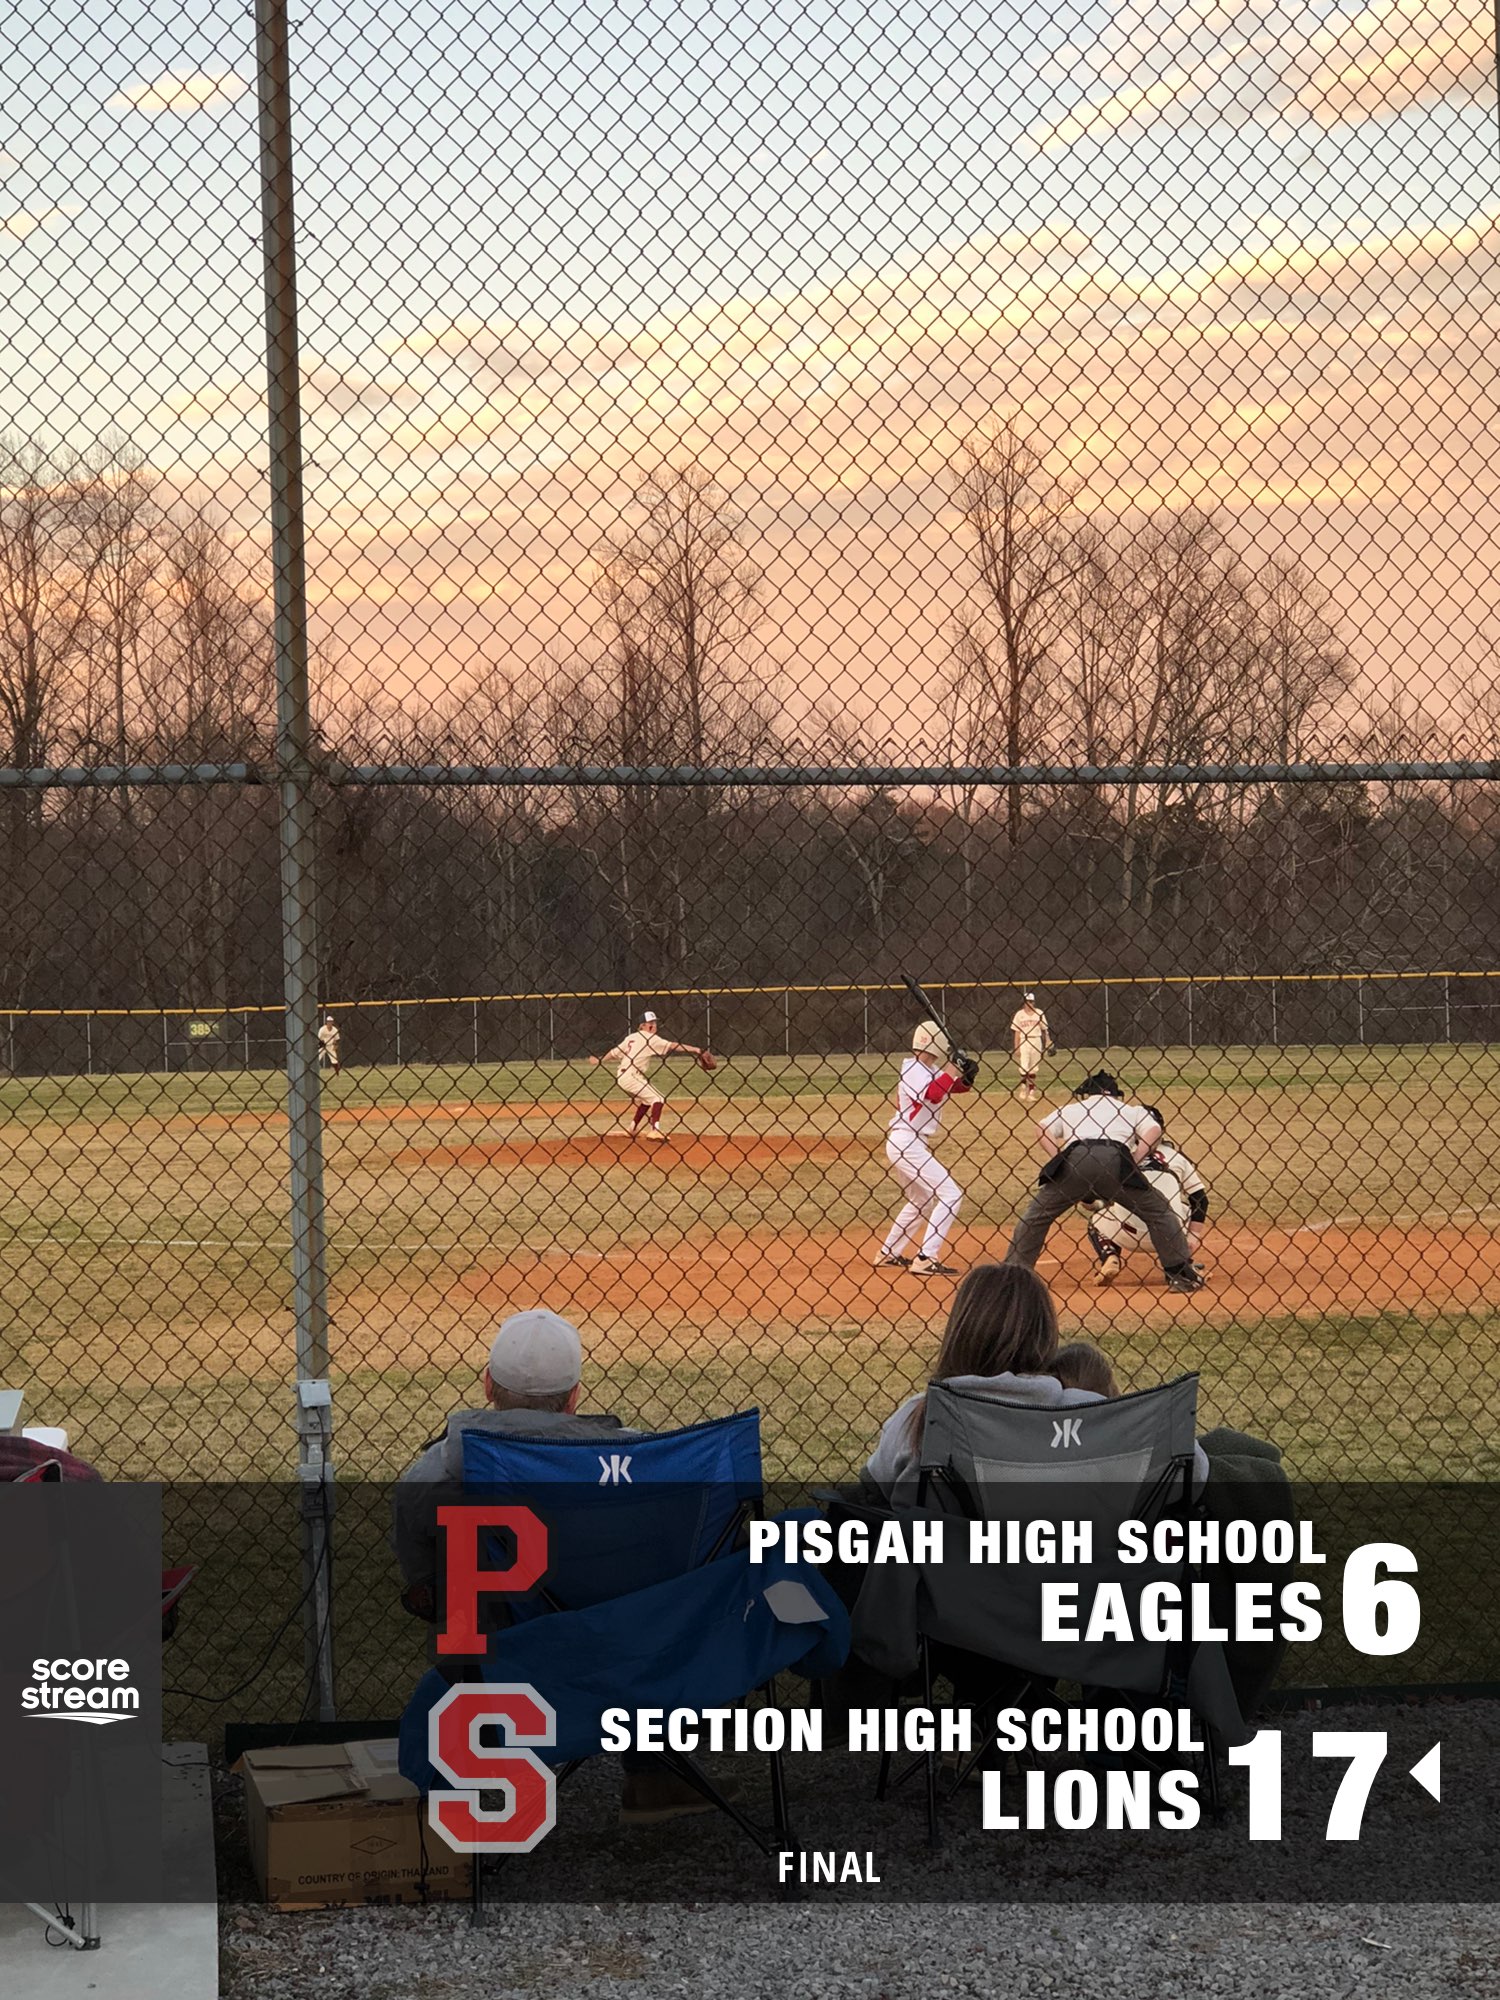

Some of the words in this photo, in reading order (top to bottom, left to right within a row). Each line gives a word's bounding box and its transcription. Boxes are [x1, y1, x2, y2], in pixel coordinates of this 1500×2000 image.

[298, 1872, 346, 1885] COUNTRY
[347, 1871, 361, 1881] OF
[401, 1866, 449, 1878] THAAND
